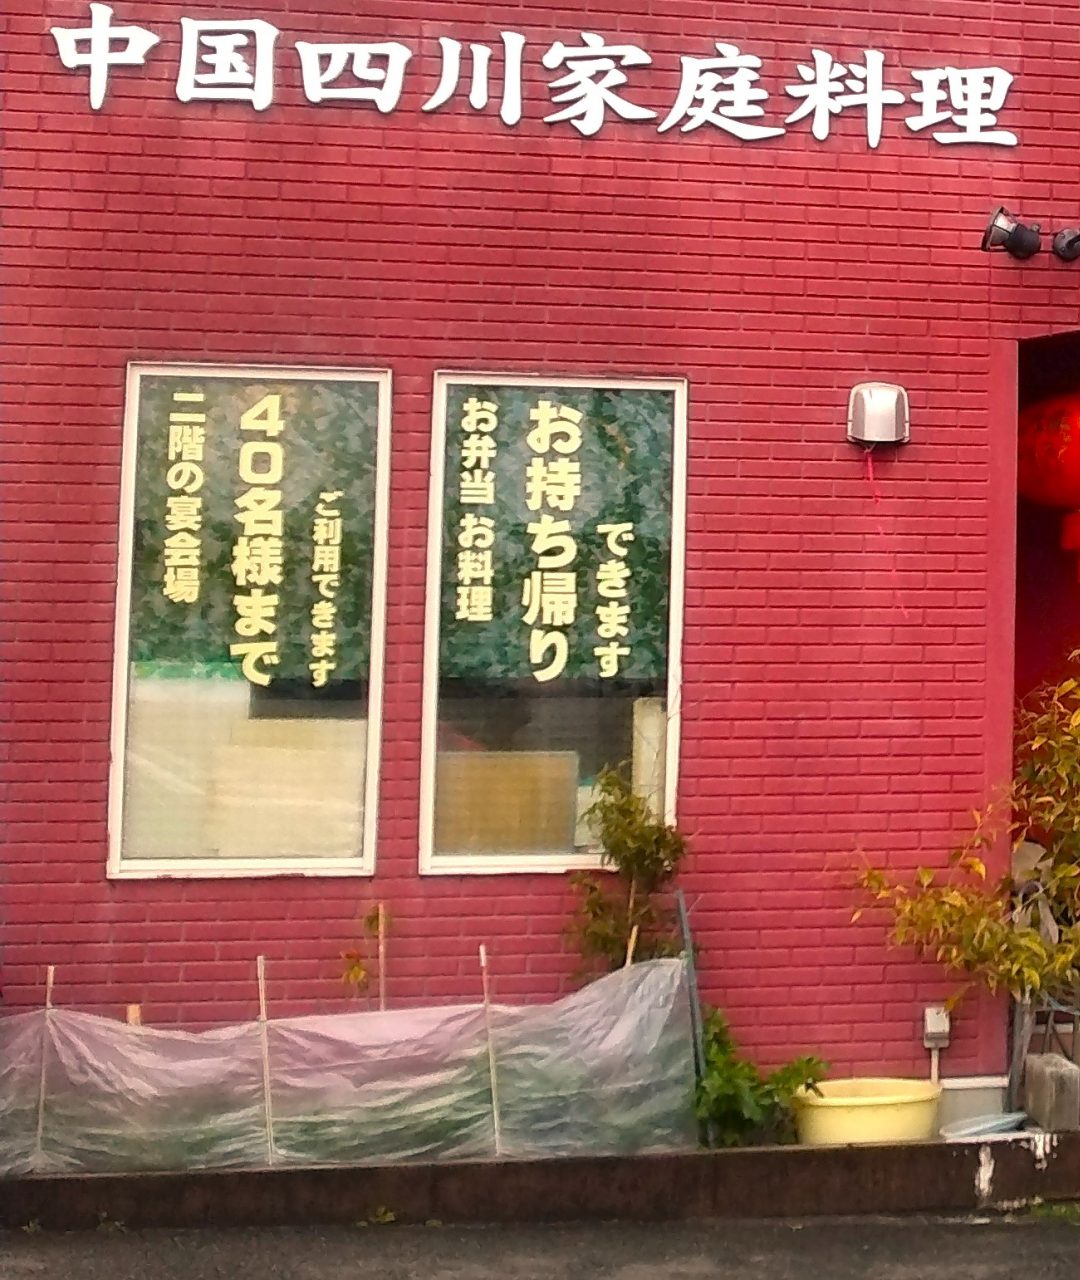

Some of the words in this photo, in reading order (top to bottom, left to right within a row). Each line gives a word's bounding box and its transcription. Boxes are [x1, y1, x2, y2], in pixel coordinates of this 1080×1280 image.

[50, 2, 1018, 148] 中国四川家庭料理
[163, 392, 206, 604] 二階の宴会場
[308, 490, 346, 688] ご利用できます
[521, 399, 584, 684] お持ち帰り
[594, 521, 636, 680] できます
